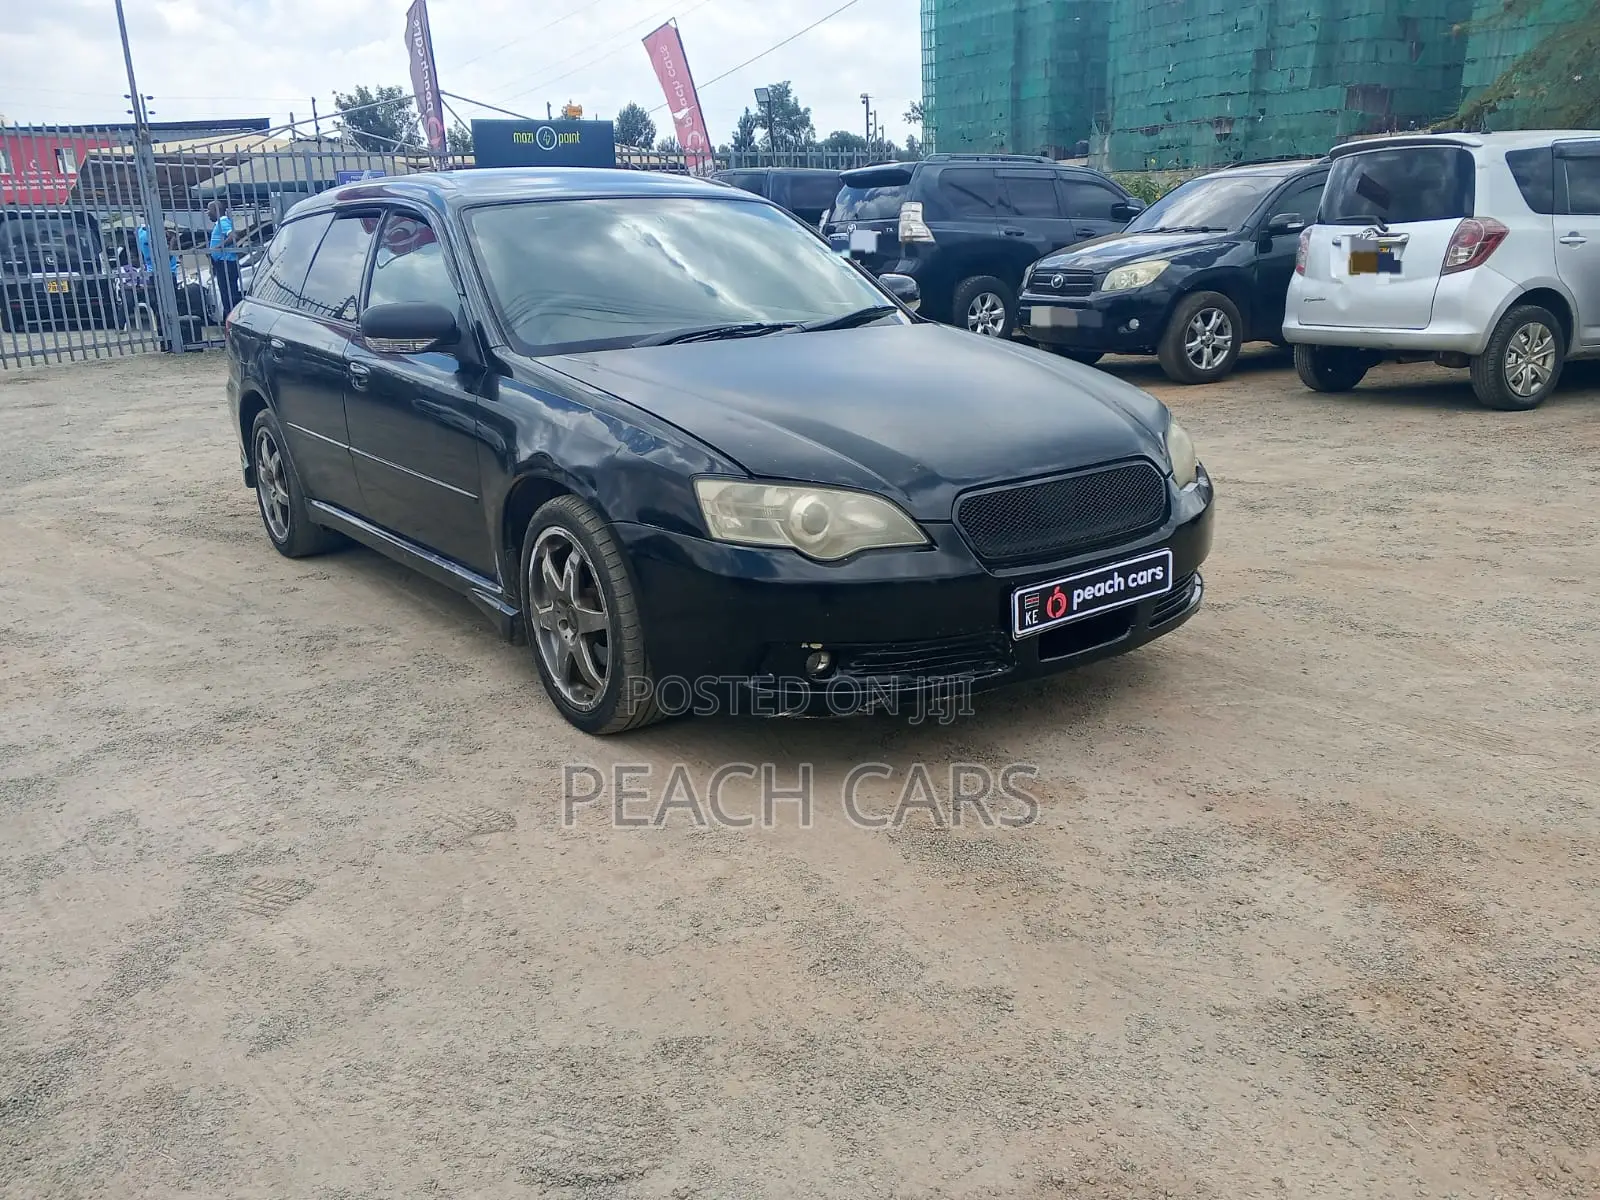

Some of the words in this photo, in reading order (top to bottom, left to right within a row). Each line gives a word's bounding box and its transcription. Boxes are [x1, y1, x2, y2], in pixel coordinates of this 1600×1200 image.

[558, 130, 580, 147] point
[1073, 572, 1124, 610] peach
[1128, 566, 1164, 587] cars
[1025, 609, 1039, 626] KE
